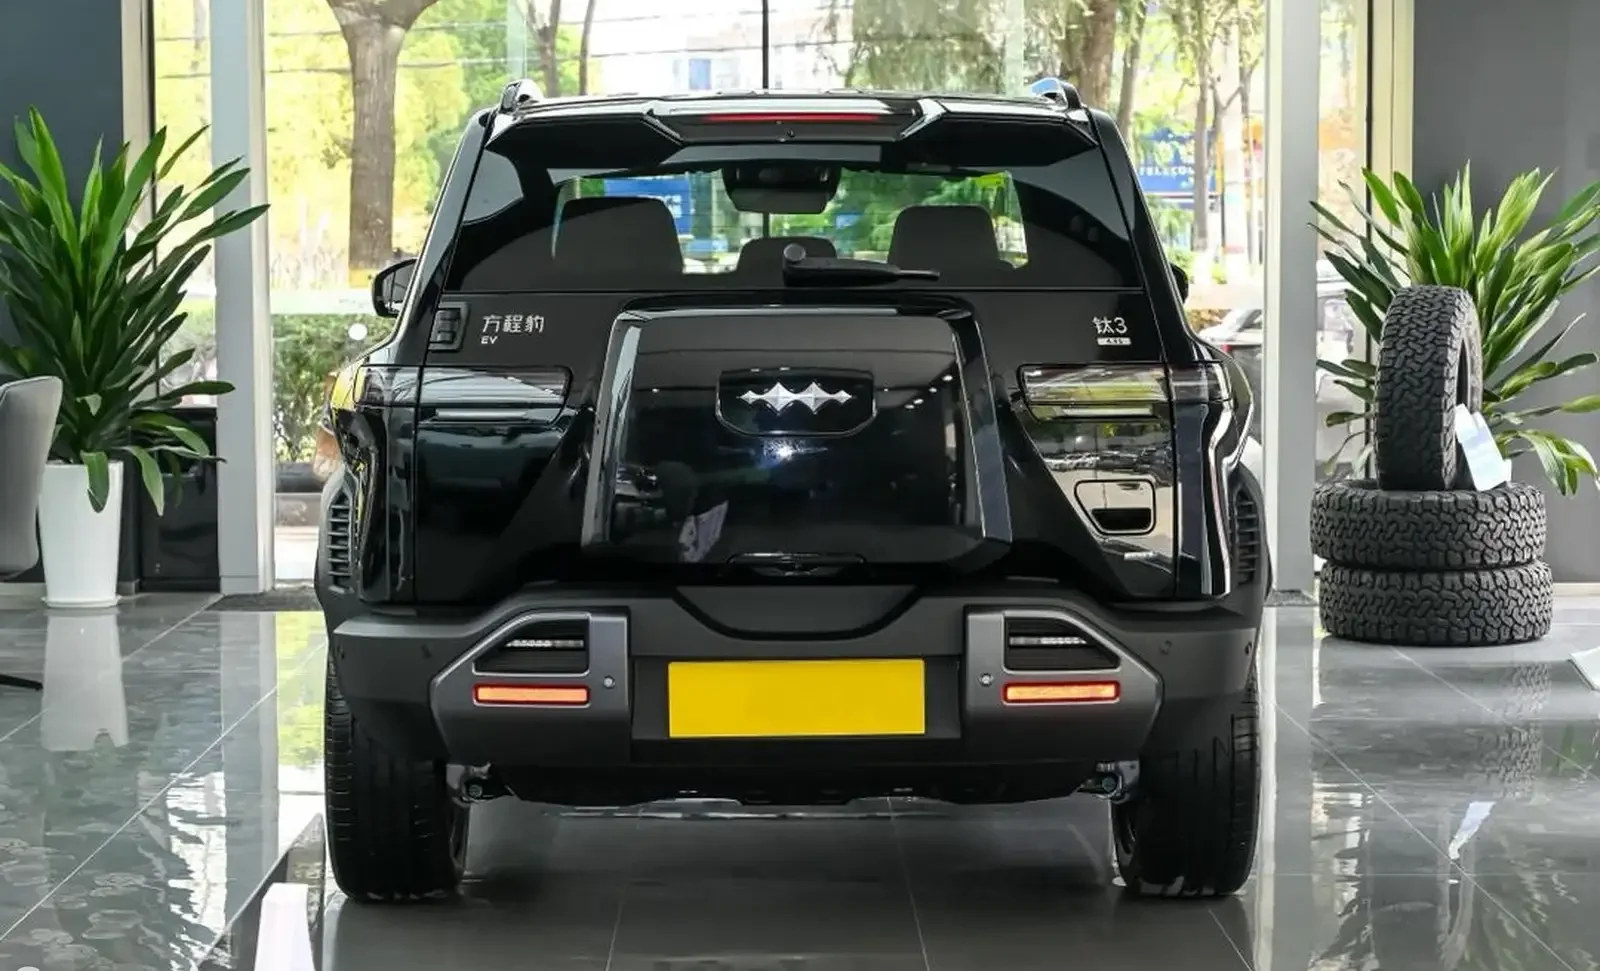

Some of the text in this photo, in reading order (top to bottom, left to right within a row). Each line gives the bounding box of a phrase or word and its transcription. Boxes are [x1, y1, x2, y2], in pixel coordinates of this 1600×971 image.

[482, 314, 545, 333] 方程豹
[1092, 316, 1128, 334] 钛3
[481, 335, 498, 345] EV
